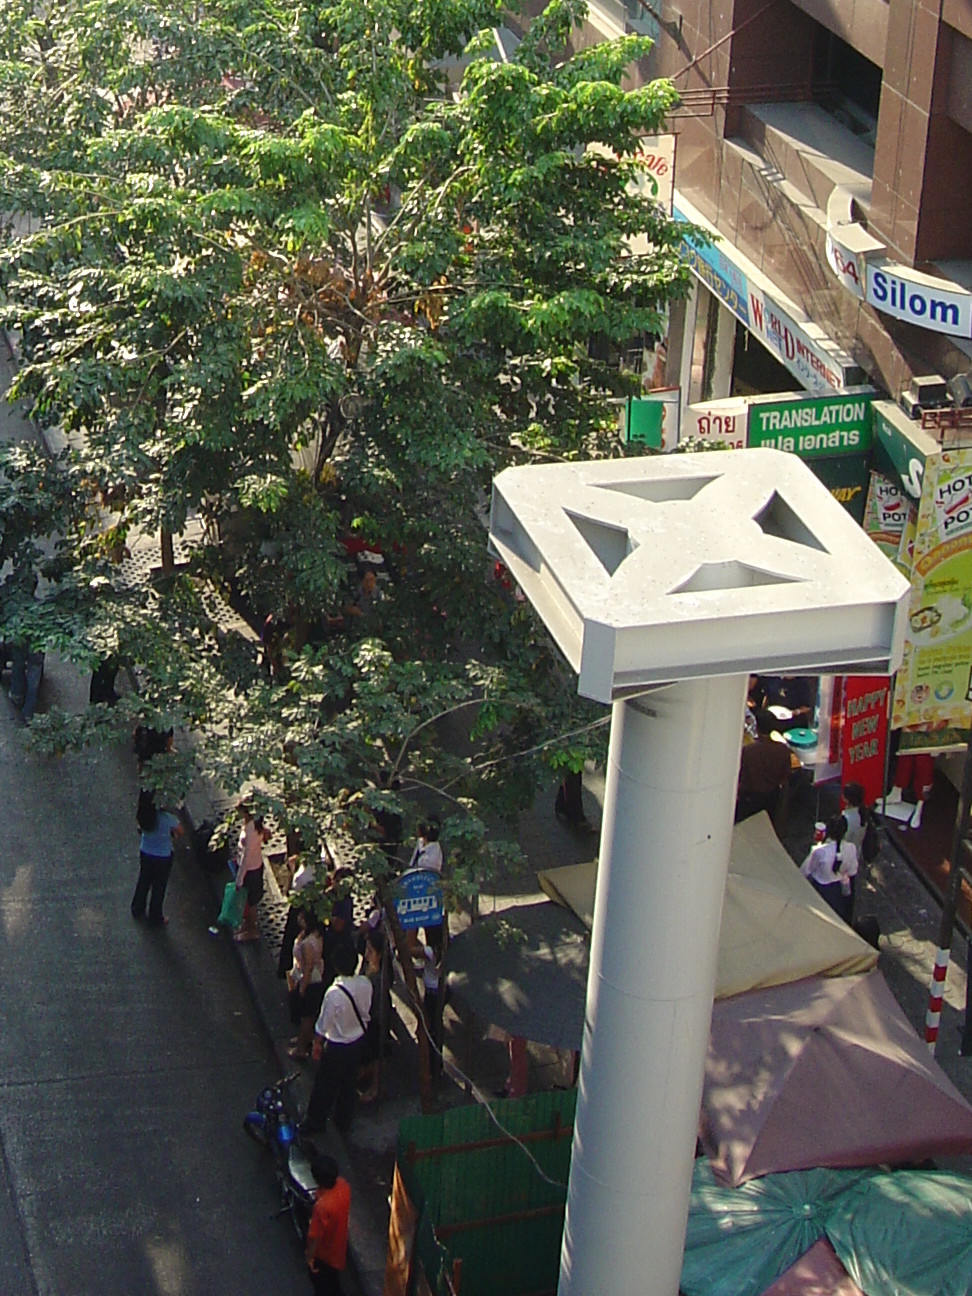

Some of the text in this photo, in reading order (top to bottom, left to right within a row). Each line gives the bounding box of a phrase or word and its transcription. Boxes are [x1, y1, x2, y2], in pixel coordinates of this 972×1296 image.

[872, 271, 960, 326] Silom
[795, 336, 842, 389] INTERNET
[696, 410, 736, 435] ถ่าย
[759, 403, 866, 432] TRANSLATION
[799, 429, 860, 451] เอกสาร
[879, 486, 904, 497] HO
[847, 687, 888, 719] HAPPY
[852, 714, 879, 741] NEW
[848, 738, 879, 765] YEAR
